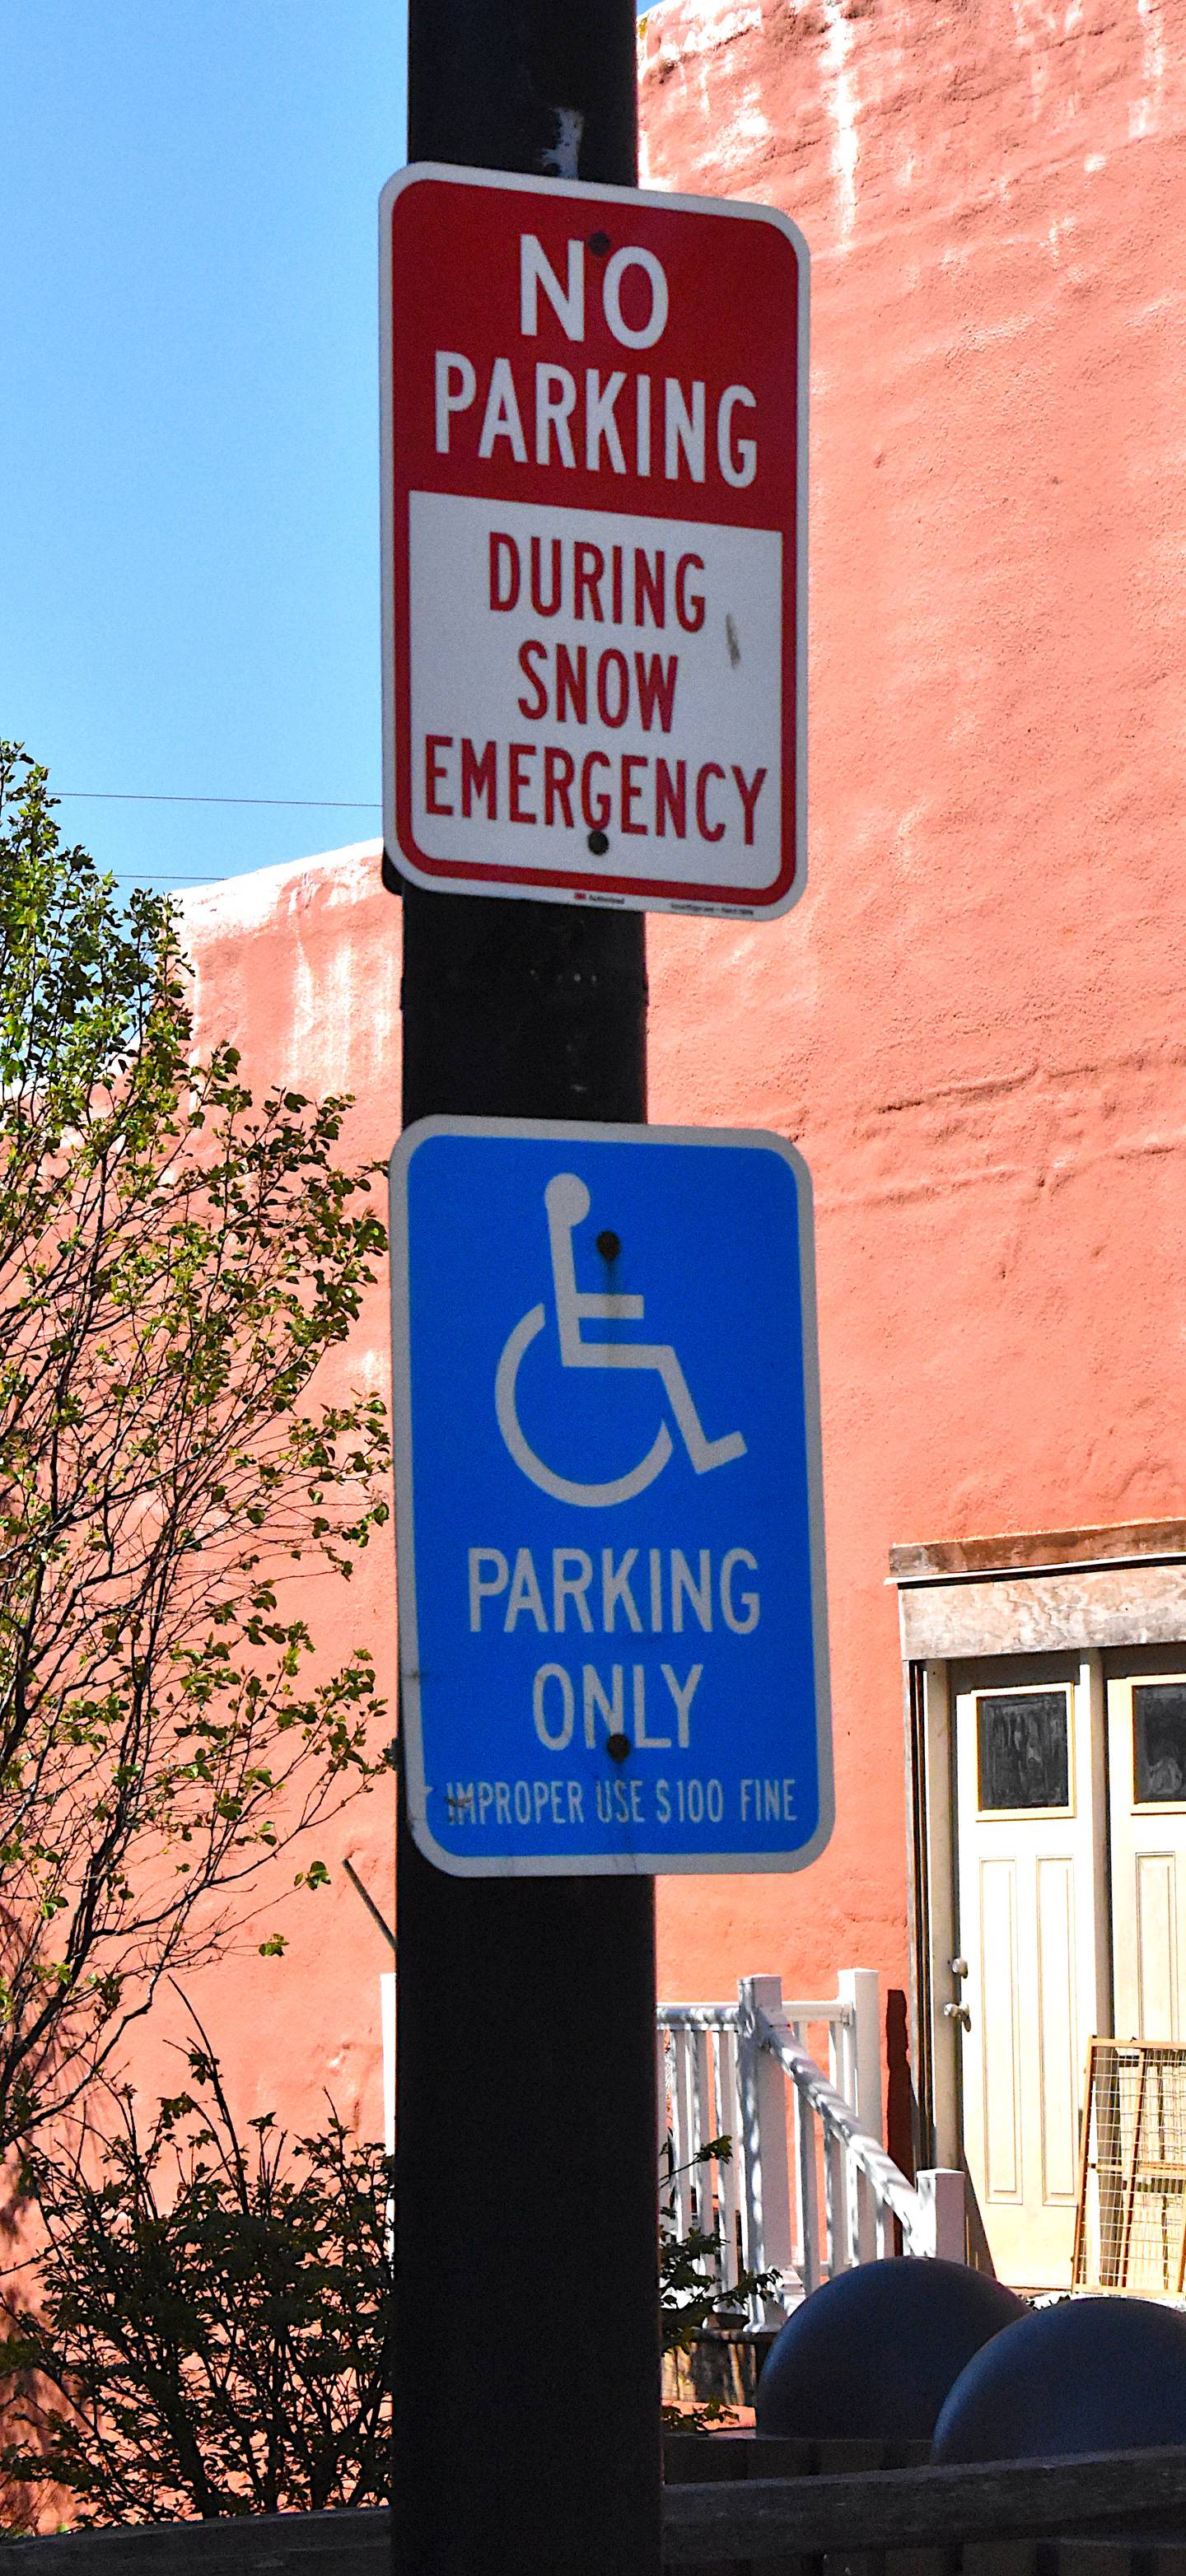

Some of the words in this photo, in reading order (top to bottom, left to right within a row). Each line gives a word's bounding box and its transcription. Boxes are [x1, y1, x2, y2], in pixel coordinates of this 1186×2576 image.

[521, 234, 669, 350] NO
[435, 350, 757, 488] PARKING
[489, 531, 706, 632] DURING
[517, 640, 679, 733] SNOW
[425, 735, 767, 846] EMERGENCY
[468, 1547, 760, 1634] PARKING
[533, 1663, 703, 1751] ONLY
[446, 1780, 585, 1825] IMPROPER
[595, 1779, 644, 1823] USE
[656, 1778, 723, 1823] $100
[740, 1777, 798, 1822] FINE
